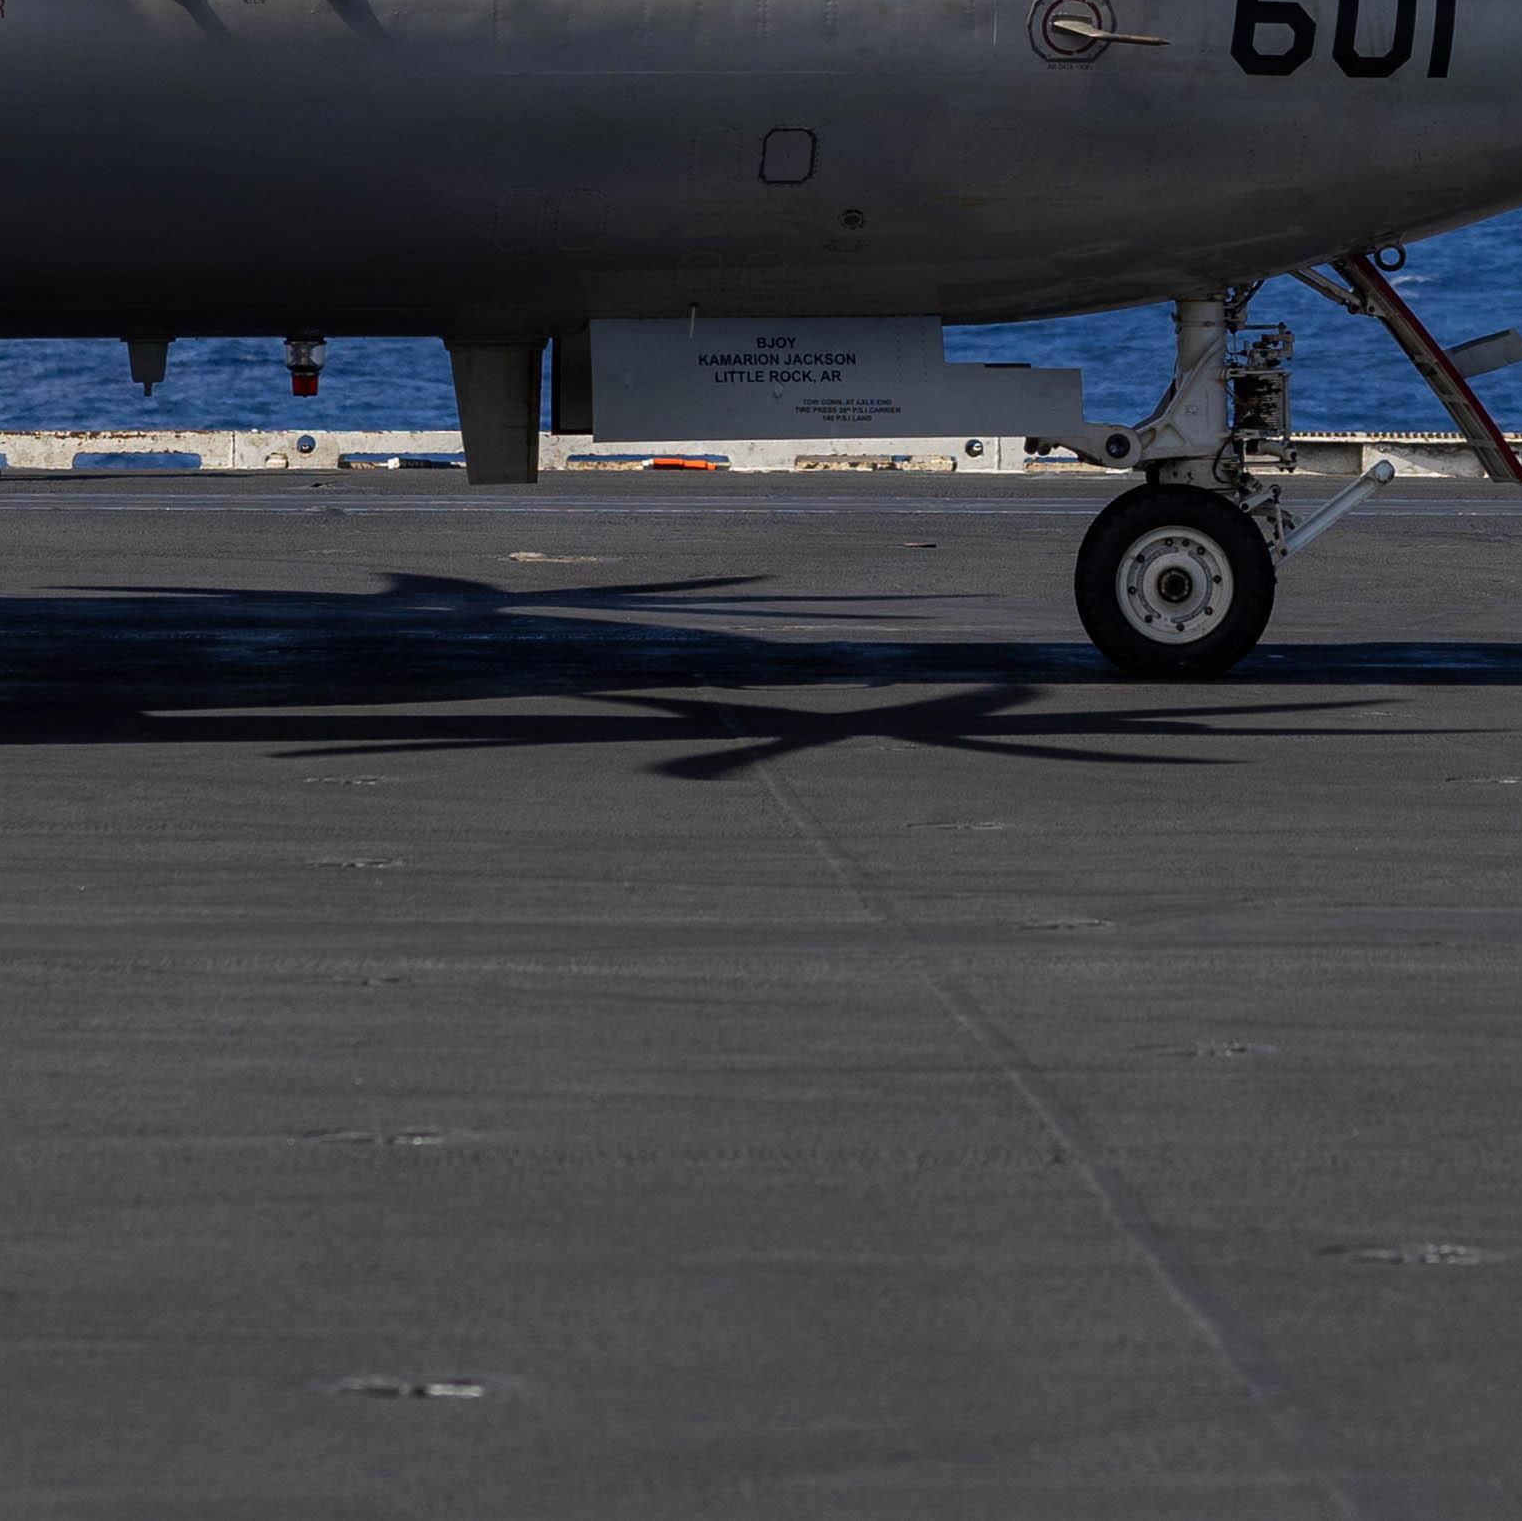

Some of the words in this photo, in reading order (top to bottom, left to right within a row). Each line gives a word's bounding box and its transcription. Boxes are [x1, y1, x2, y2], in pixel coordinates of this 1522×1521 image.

[756, 337, 796, 349] BJOY
[698, 354, 779, 366] KAMARION
[784, 353, 856, 366] JACKSON
[715, 371, 764, 383] LITTLE
[769, 370, 817, 384] ROCK,
[820, 370, 842, 382] AR
